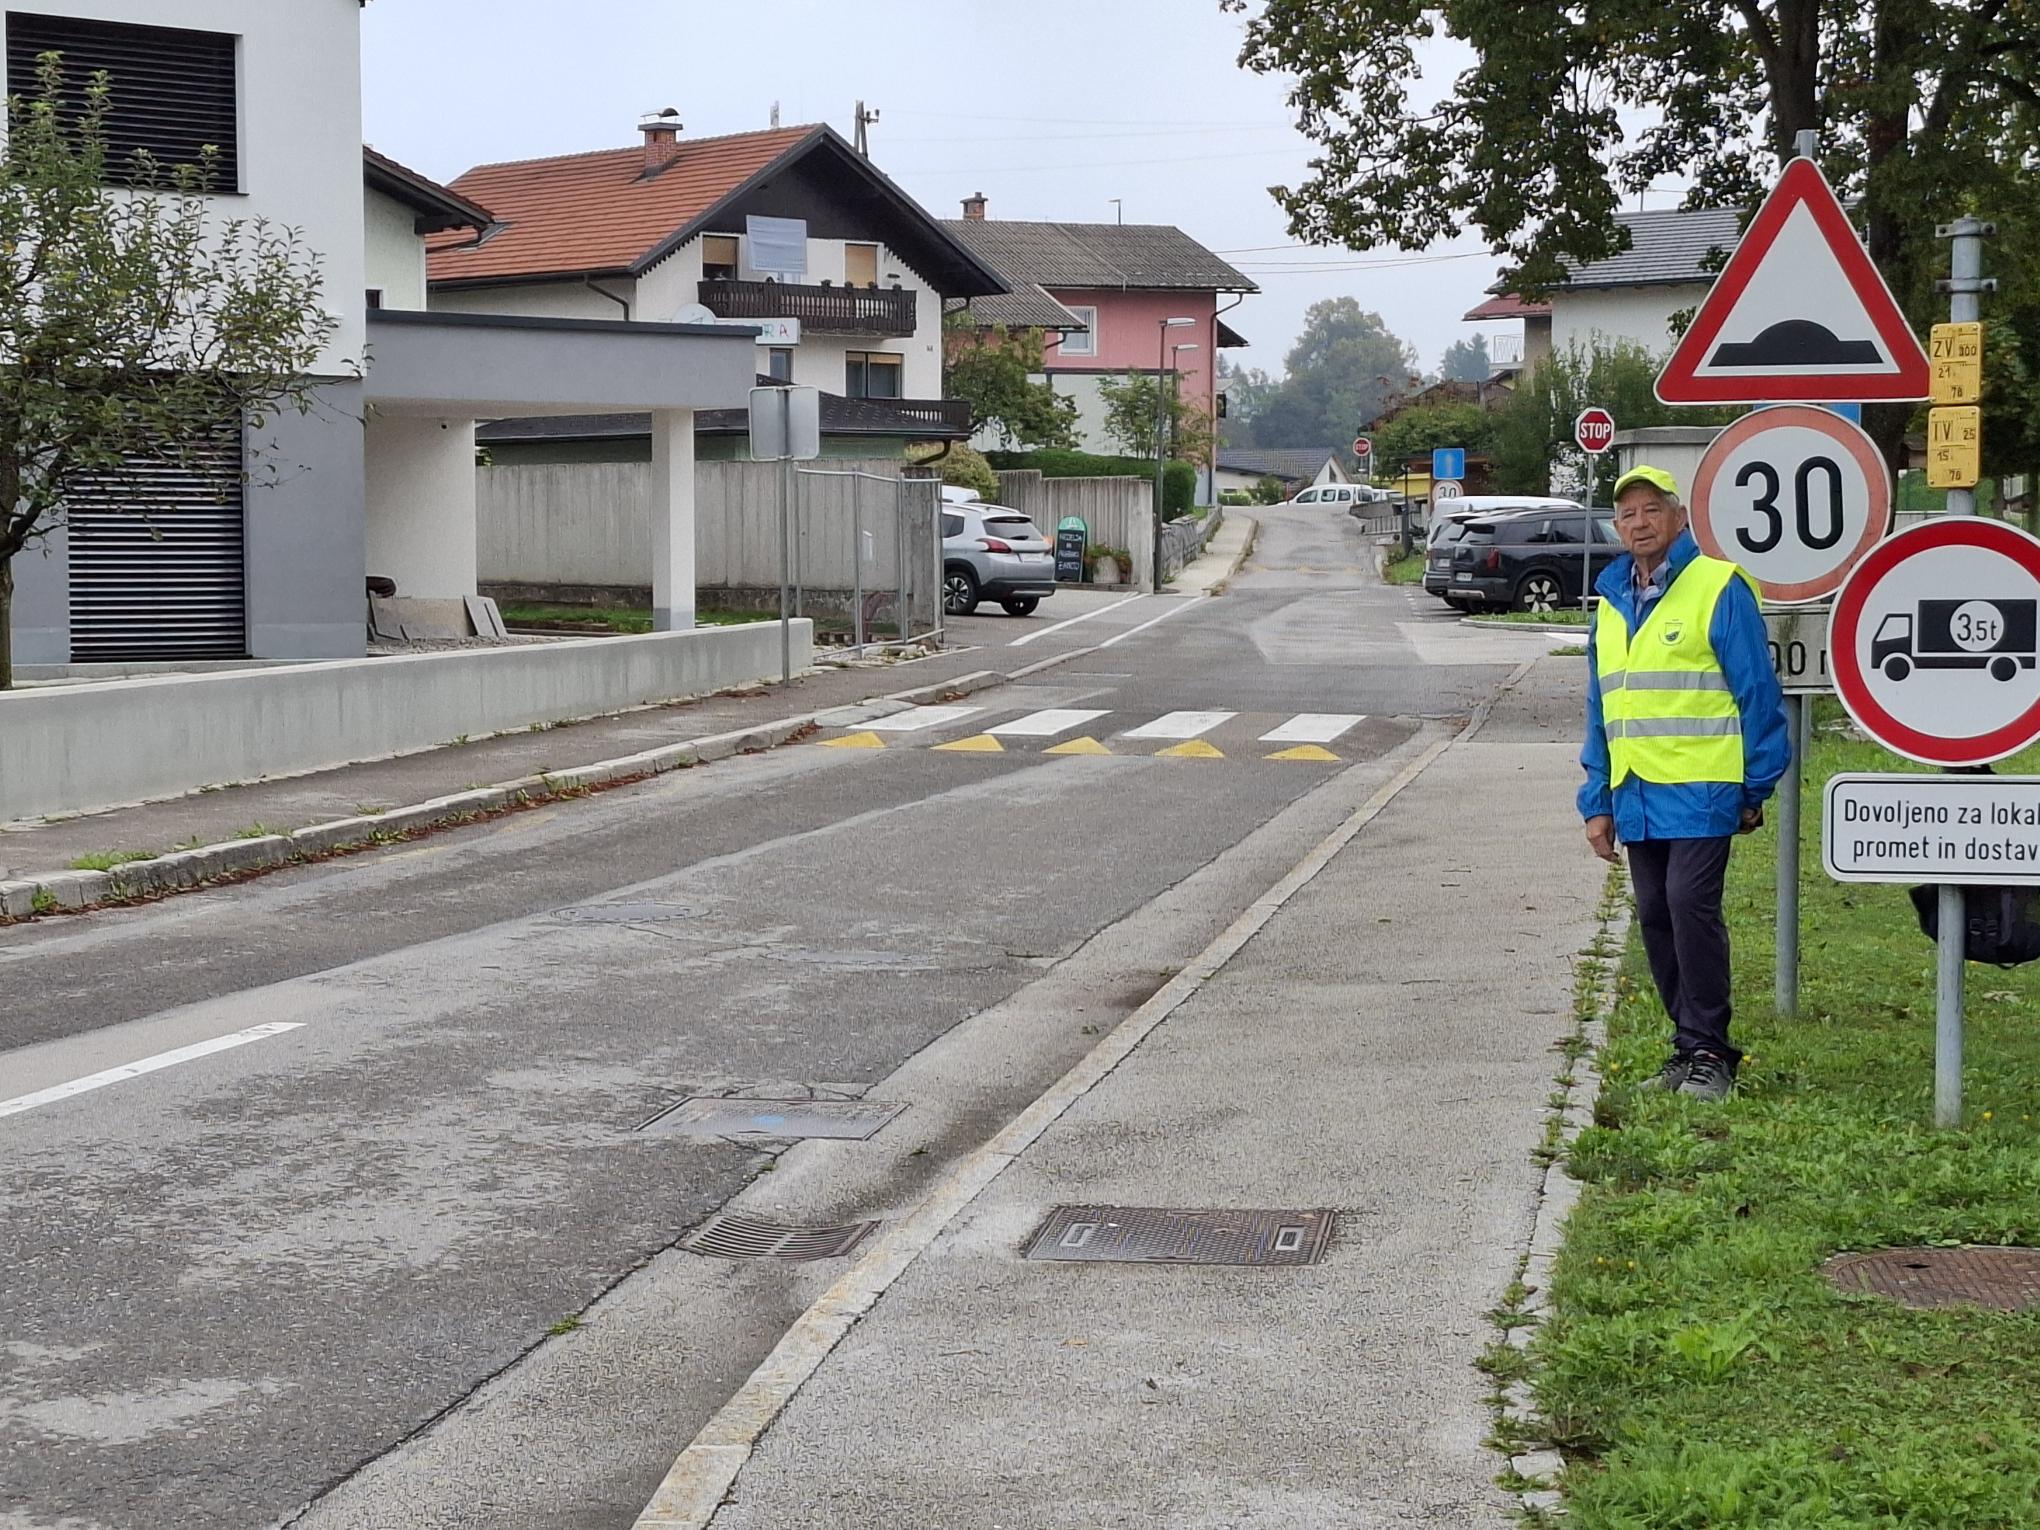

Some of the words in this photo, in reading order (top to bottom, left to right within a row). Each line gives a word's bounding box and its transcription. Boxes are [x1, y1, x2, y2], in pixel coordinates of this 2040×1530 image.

[1934, 340, 1953, 358] ZV
[1580, 422, 1611, 440] STOP
[1735, 456, 1844, 553] 30
[1844, 799, 1949, 830] Dovoljeno
[1957, 806, 1982, 825] za
[1853, 836, 1930, 863] promet
[1938, 836, 1956, 860] in
[1965, 837, 2038, 861] dostav
